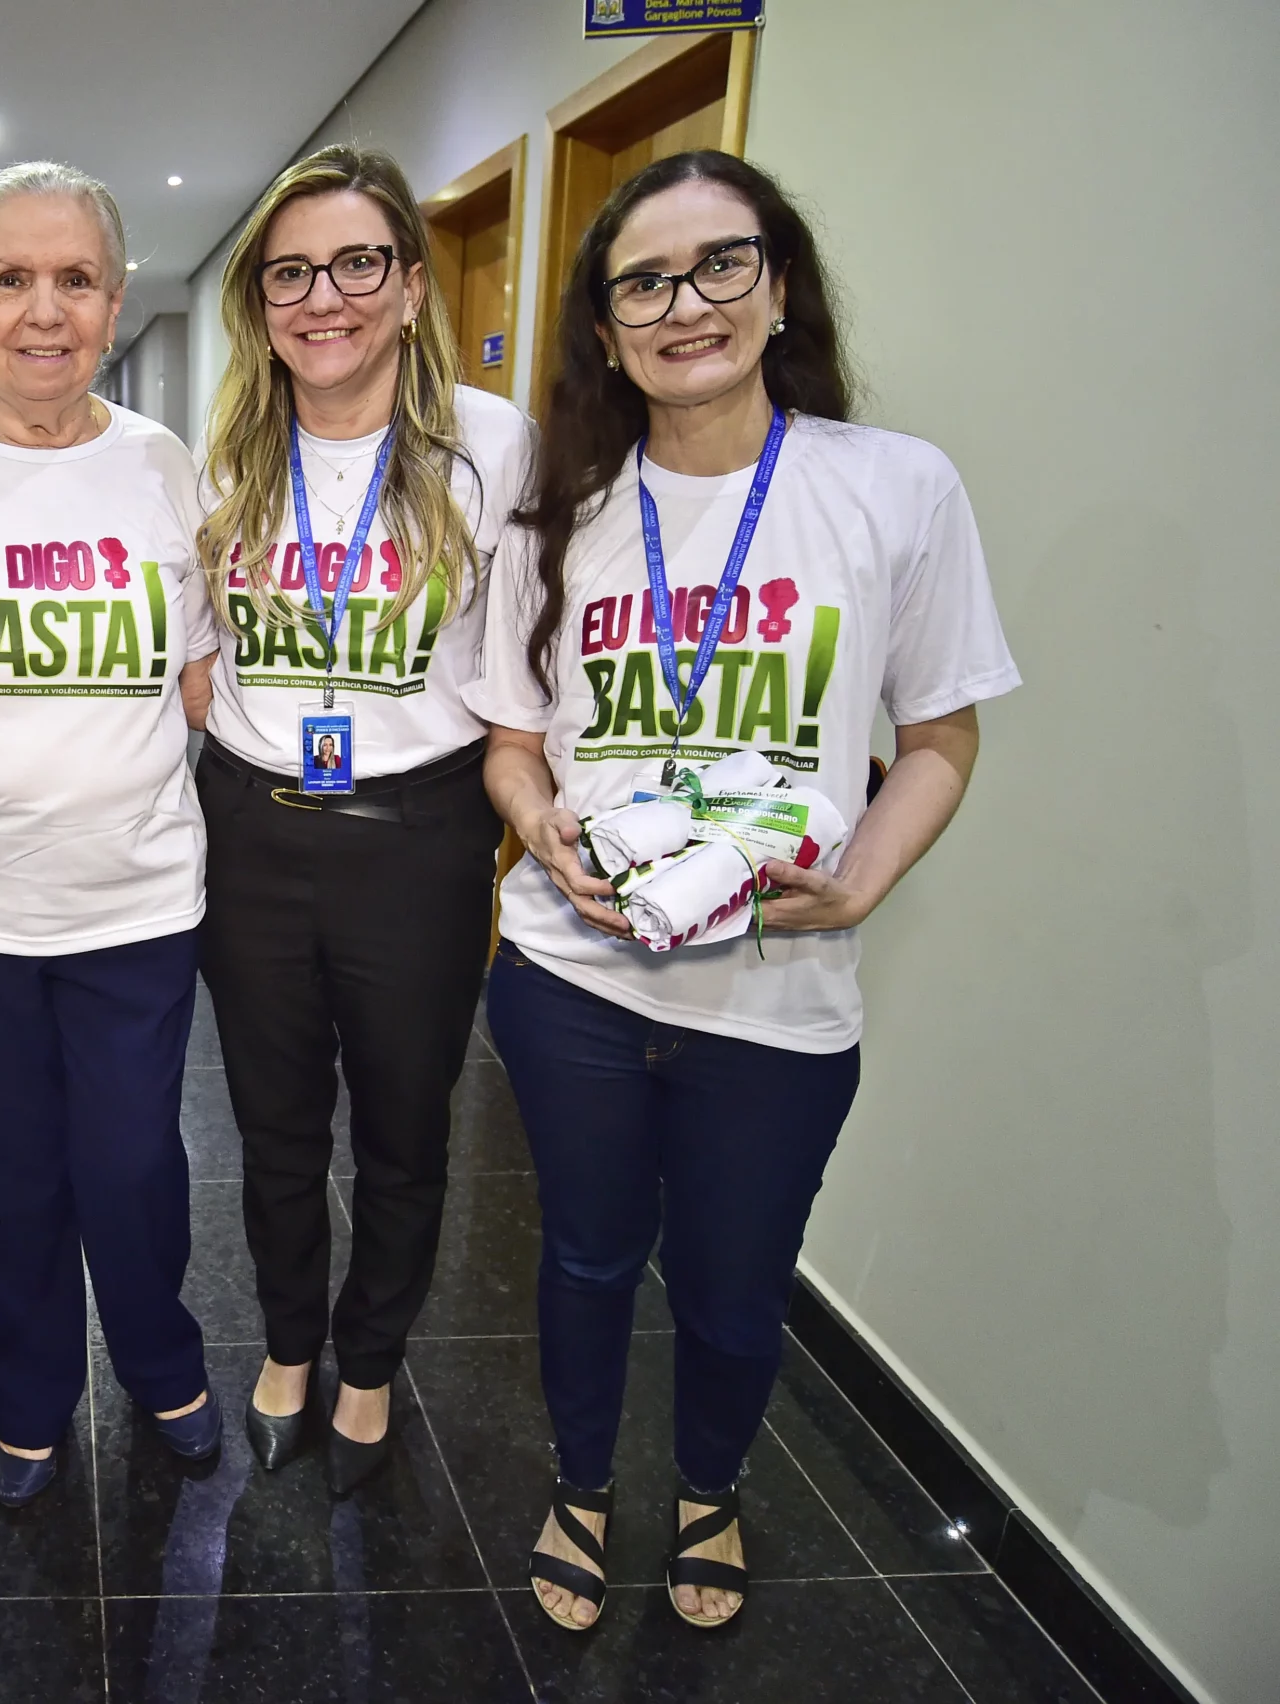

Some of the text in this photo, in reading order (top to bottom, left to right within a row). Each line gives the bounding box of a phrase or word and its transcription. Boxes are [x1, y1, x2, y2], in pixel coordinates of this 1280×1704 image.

[644, 10, 704, 22] Gargaglione
[743, 523, 755, 544] PODER
[5, 540, 96, 591] DIGO
[655, 566, 663, 585] PODER
[334, 589, 344, 607] PODER
[228, 558, 448, 679] BASTA!
[581, 594, 633, 656] EU
[711, 619, 722, 640] PODER
[579, 605, 840, 748] BASTA!
[51, 686, 88, 694] VIOLÊNCIA
[90, 687, 128, 695] DOMÉSTICA
[253, 677, 288, 685] JUDICIÁRIO
[363, 683, 399, 695] DOMÉSTICA
[600, 748, 638, 757] JUDICIÁRIO
[683, 749, 728, 759] VIOLÊNCIA
[711, 806, 736, 814] PAPEL
[723, 798, 756, 807] Evento
